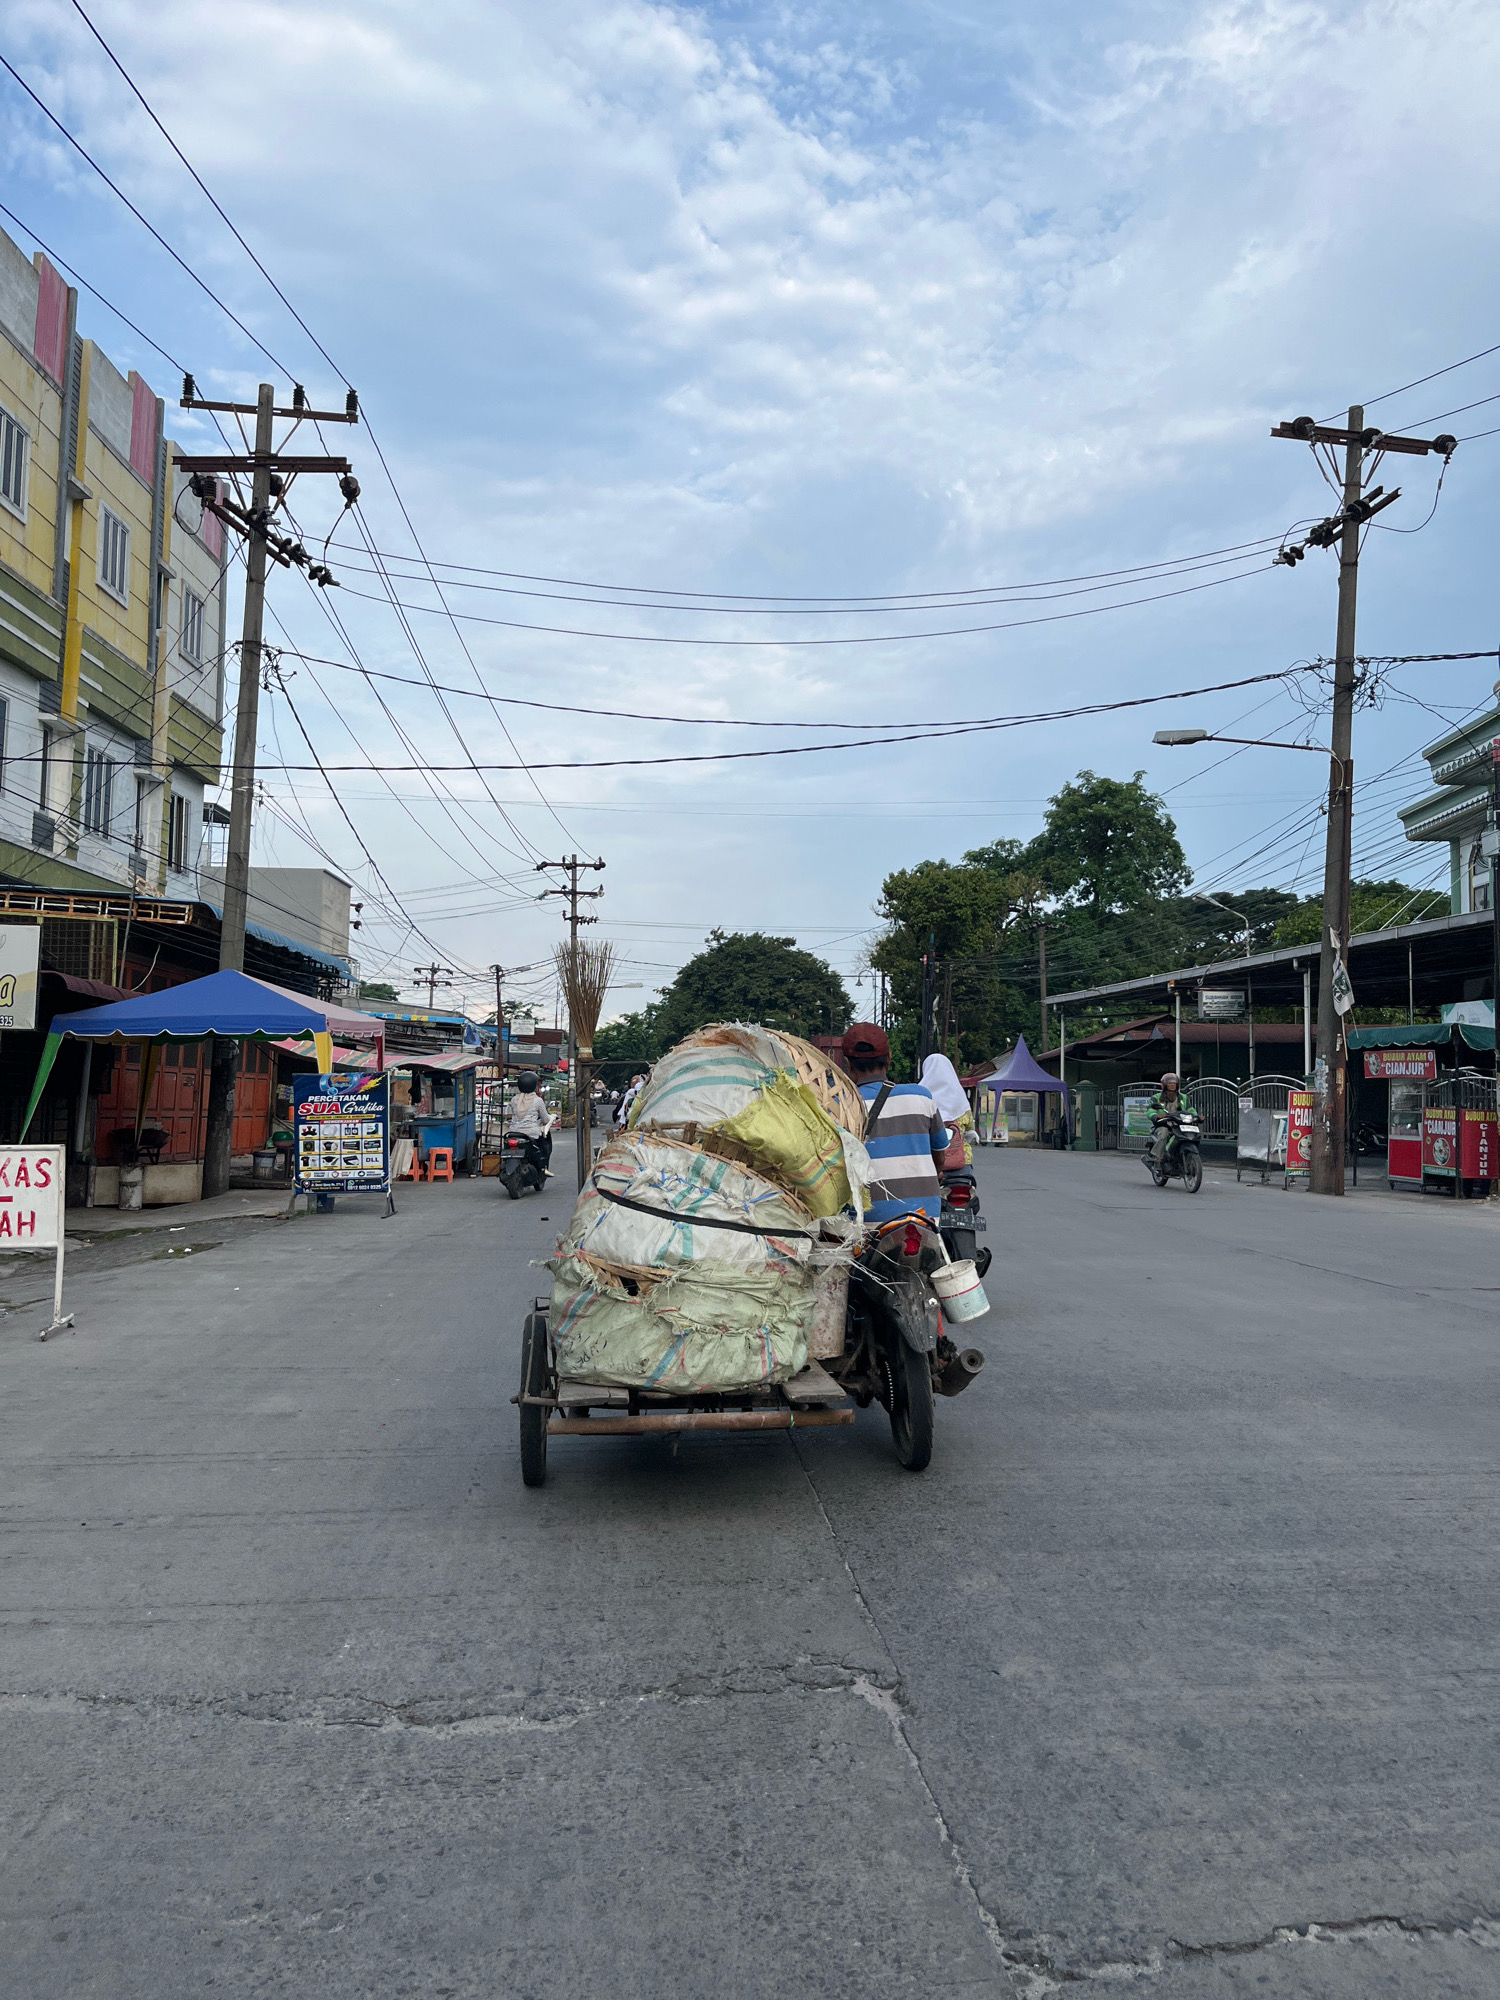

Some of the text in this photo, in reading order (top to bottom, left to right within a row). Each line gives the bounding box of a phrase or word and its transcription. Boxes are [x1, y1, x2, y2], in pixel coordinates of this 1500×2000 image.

[1382, 1052, 1427, 1062] BUBUR AYAM
[1381, 1062, 1430, 1076] "CIANJUR"
[308, 1094, 369, 1102] PERCETAKAN
[298, 1102, 385, 1115] SUA Grafika
[1426, 1109, 1443, 1119] BUBUR
[1465, 1111, 1485, 1121] BUBUR
[1479, 1123, 1488, 1176] CIANJUR
